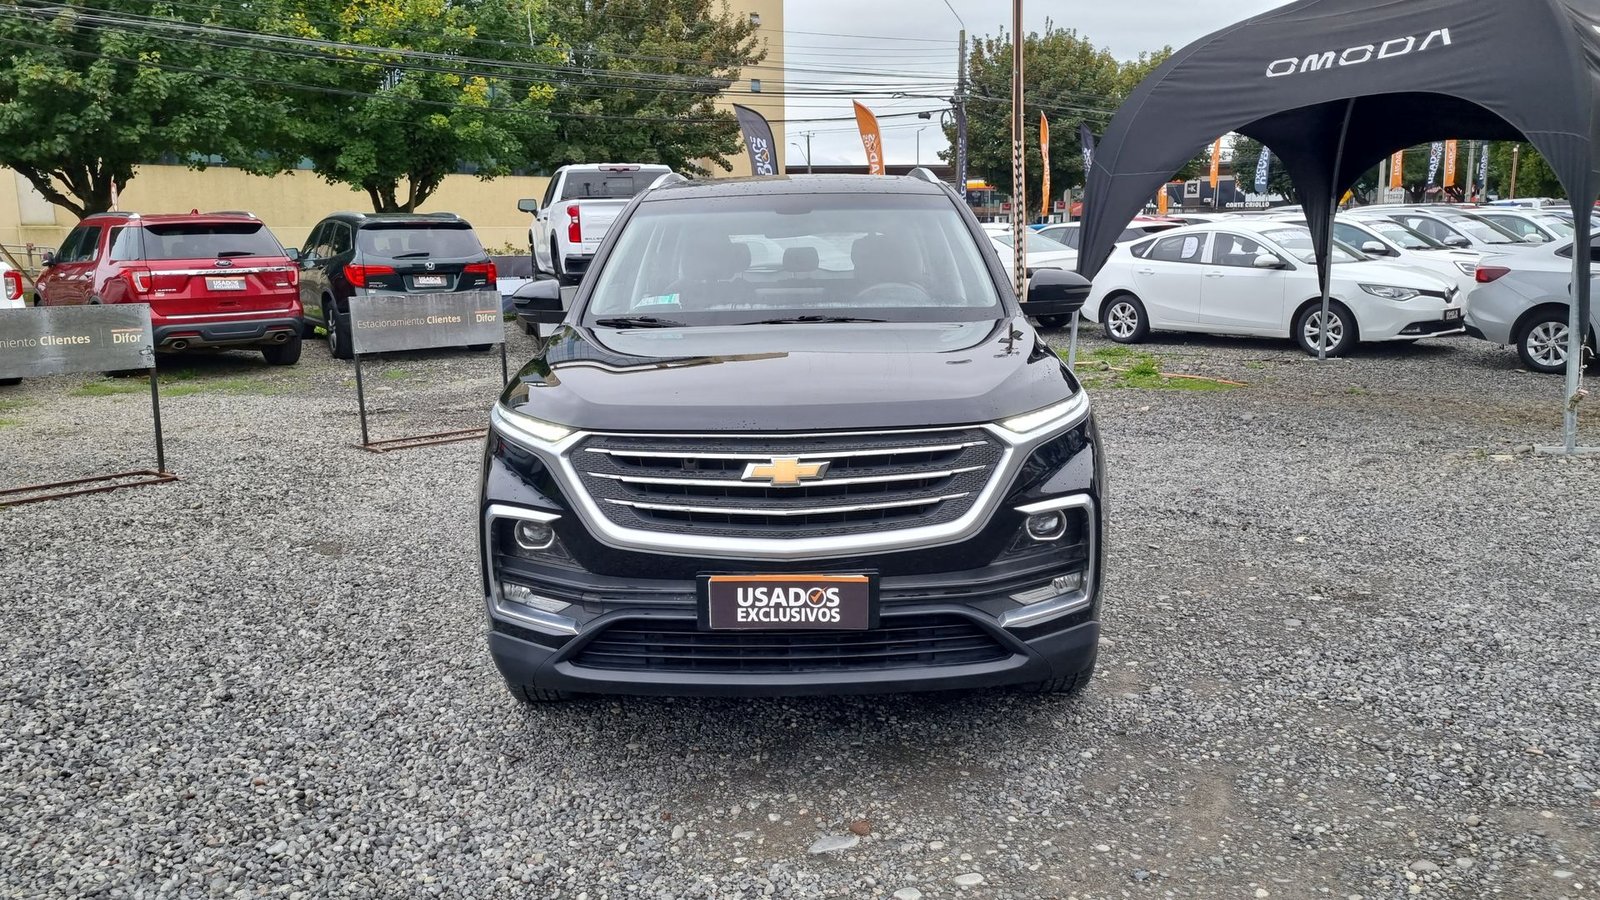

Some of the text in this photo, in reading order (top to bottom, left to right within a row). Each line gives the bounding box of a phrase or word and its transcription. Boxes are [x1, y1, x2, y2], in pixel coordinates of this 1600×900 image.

[1265, 27, 1452, 78] OMODA
[357, 314, 462, 329] Estacionamiento Clientes
[475, 313, 496, 323] Difor
[39, 335, 91, 346] Clientes
[112, 332, 142, 344] Difor
[737, 586, 840, 608] USADOS
[737, 607, 841, 622] EXCLUSIVOS
